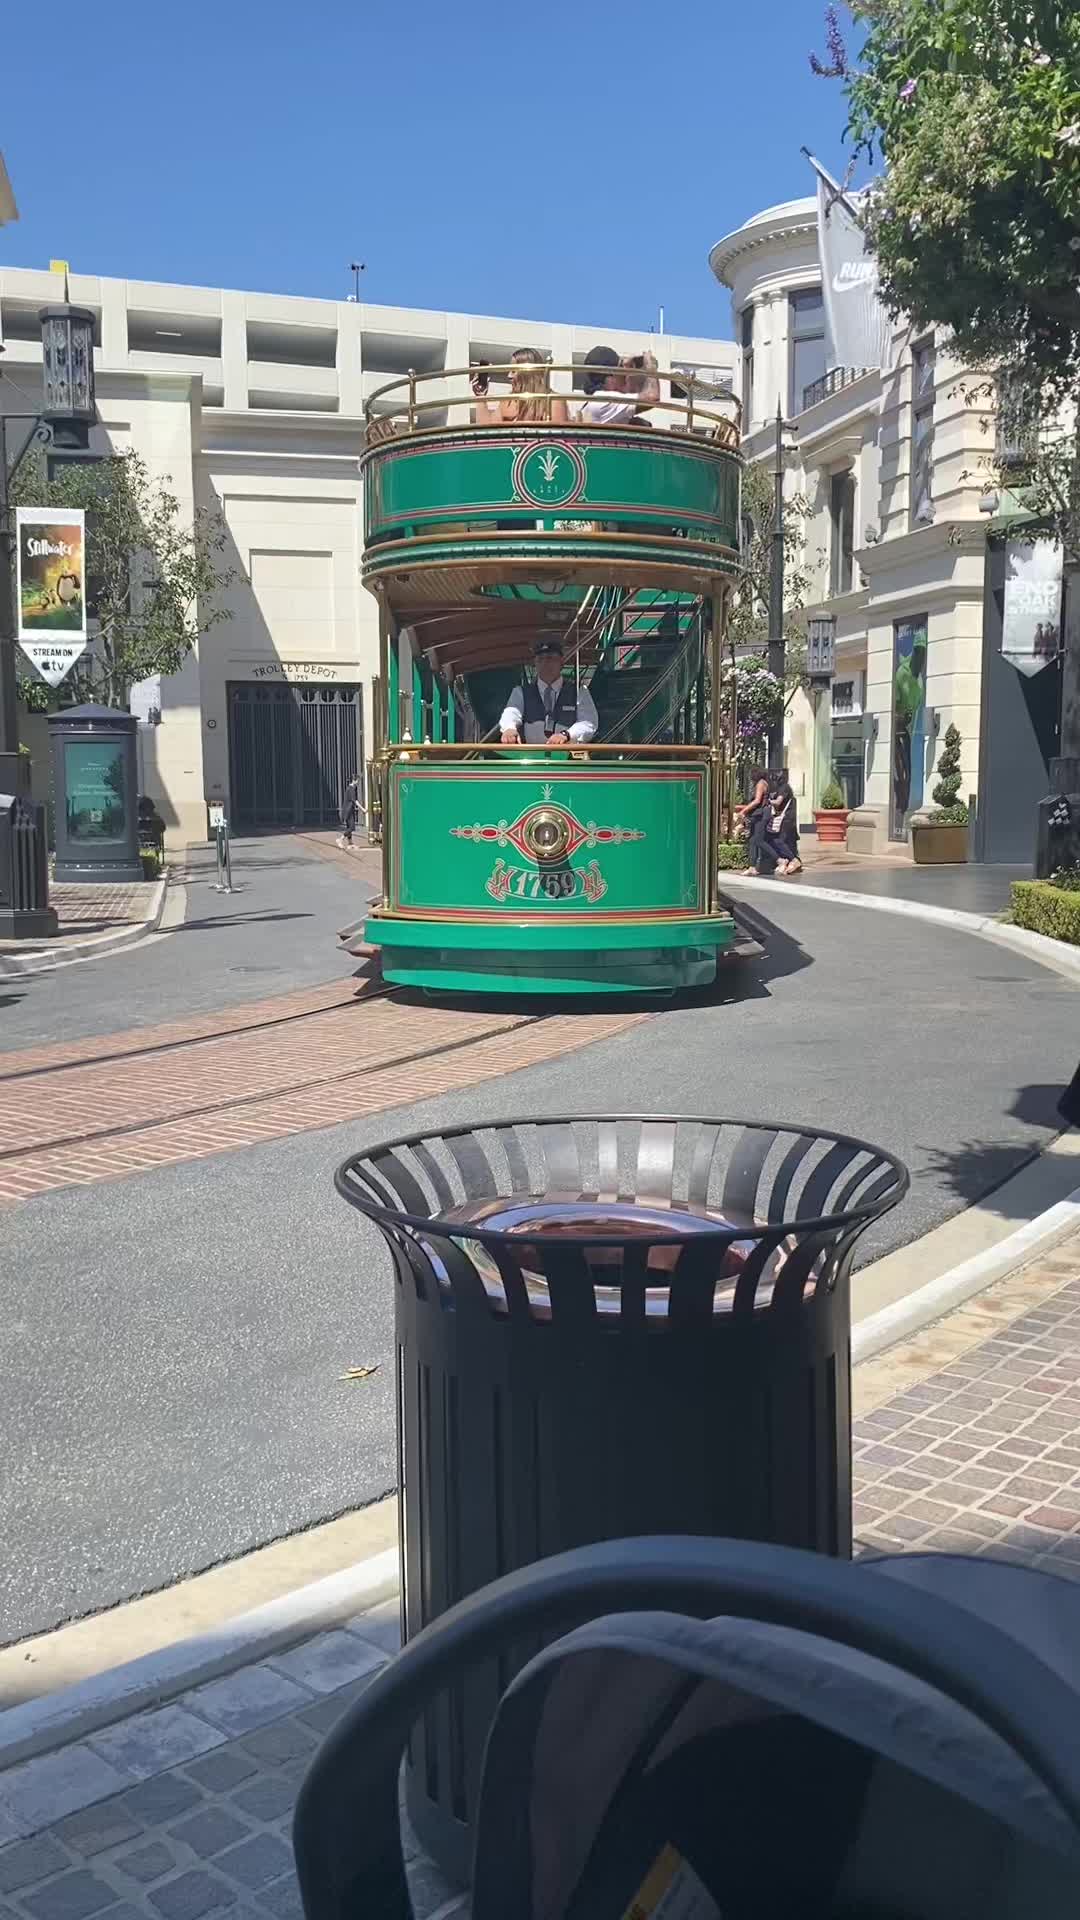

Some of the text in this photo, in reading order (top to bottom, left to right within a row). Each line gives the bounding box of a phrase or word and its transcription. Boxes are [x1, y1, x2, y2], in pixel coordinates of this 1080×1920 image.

[33, 648, 73, 657] STREAM ON
[52, 660, 64, 672] tv
[252, 663, 337, 679] TROLLEY DEPOT
[515, 871, 577, 899] 1759
